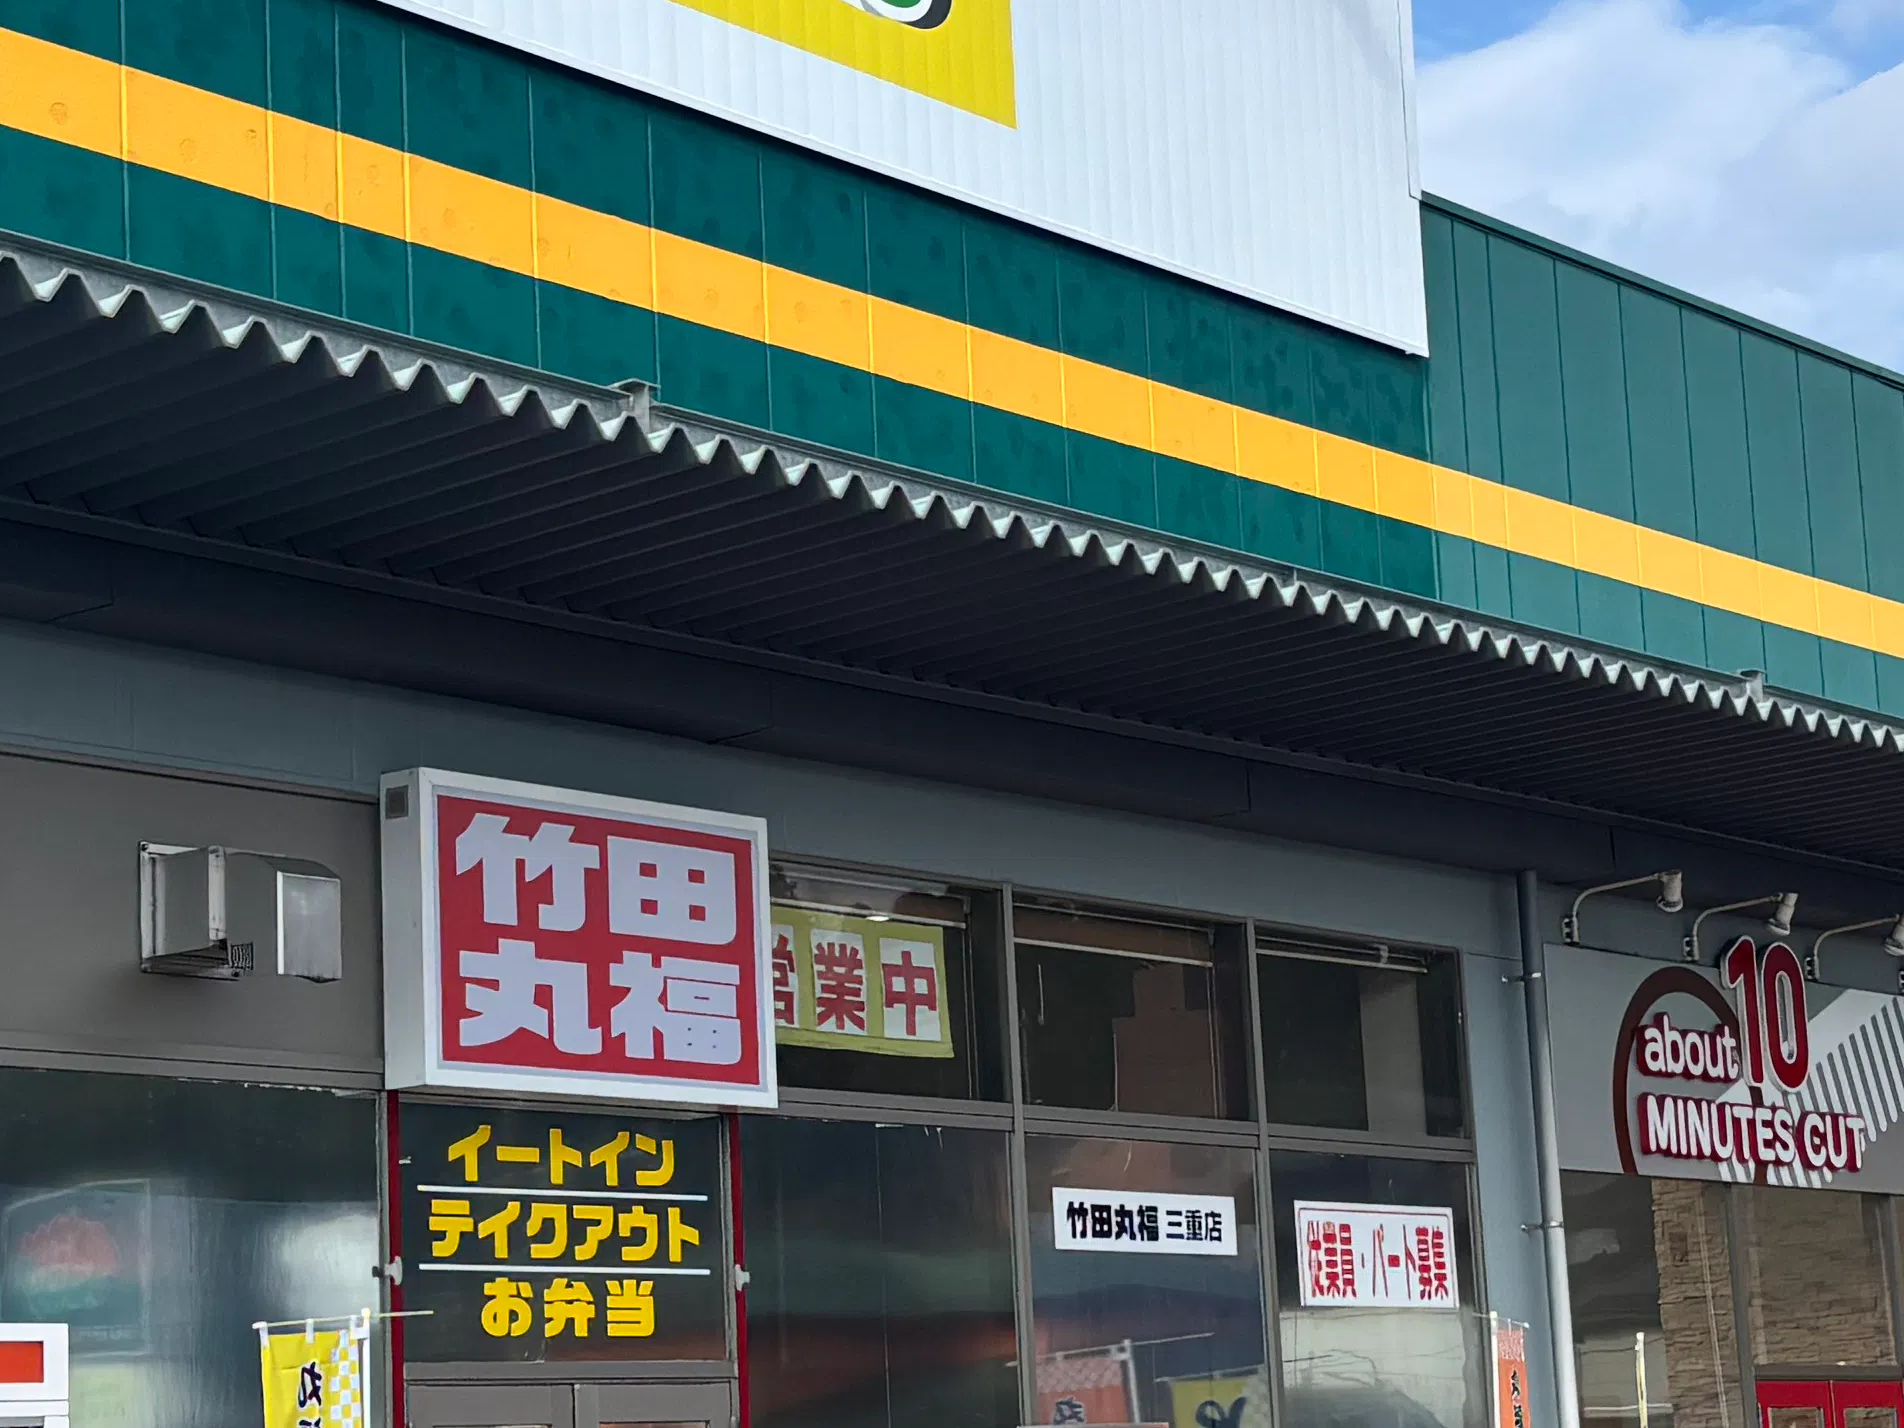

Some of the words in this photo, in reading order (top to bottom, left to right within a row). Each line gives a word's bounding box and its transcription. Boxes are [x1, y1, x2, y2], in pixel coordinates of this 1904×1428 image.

[456, 813, 736, 946] 竹田
[459, 938, 743, 1066] 丸福
[772, 933, 938, 1036] 営業中
[1644, 1023, 1741, 1080] about
[1720, 935, 1809, 1092] 10
[448, 1124, 674, 1187] イートイン
[1647, 1093, 1795, 1163] MINUTES
[1803, 1113, 1867, 1171] CUT
[429, 1199, 700, 1262] テイクアウト
[1067, 1201, 1159, 1242] 竹田丸福
[1166, 1210, 1223, 1242] 三重店
[481, 1277, 656, 1338] お弁当
